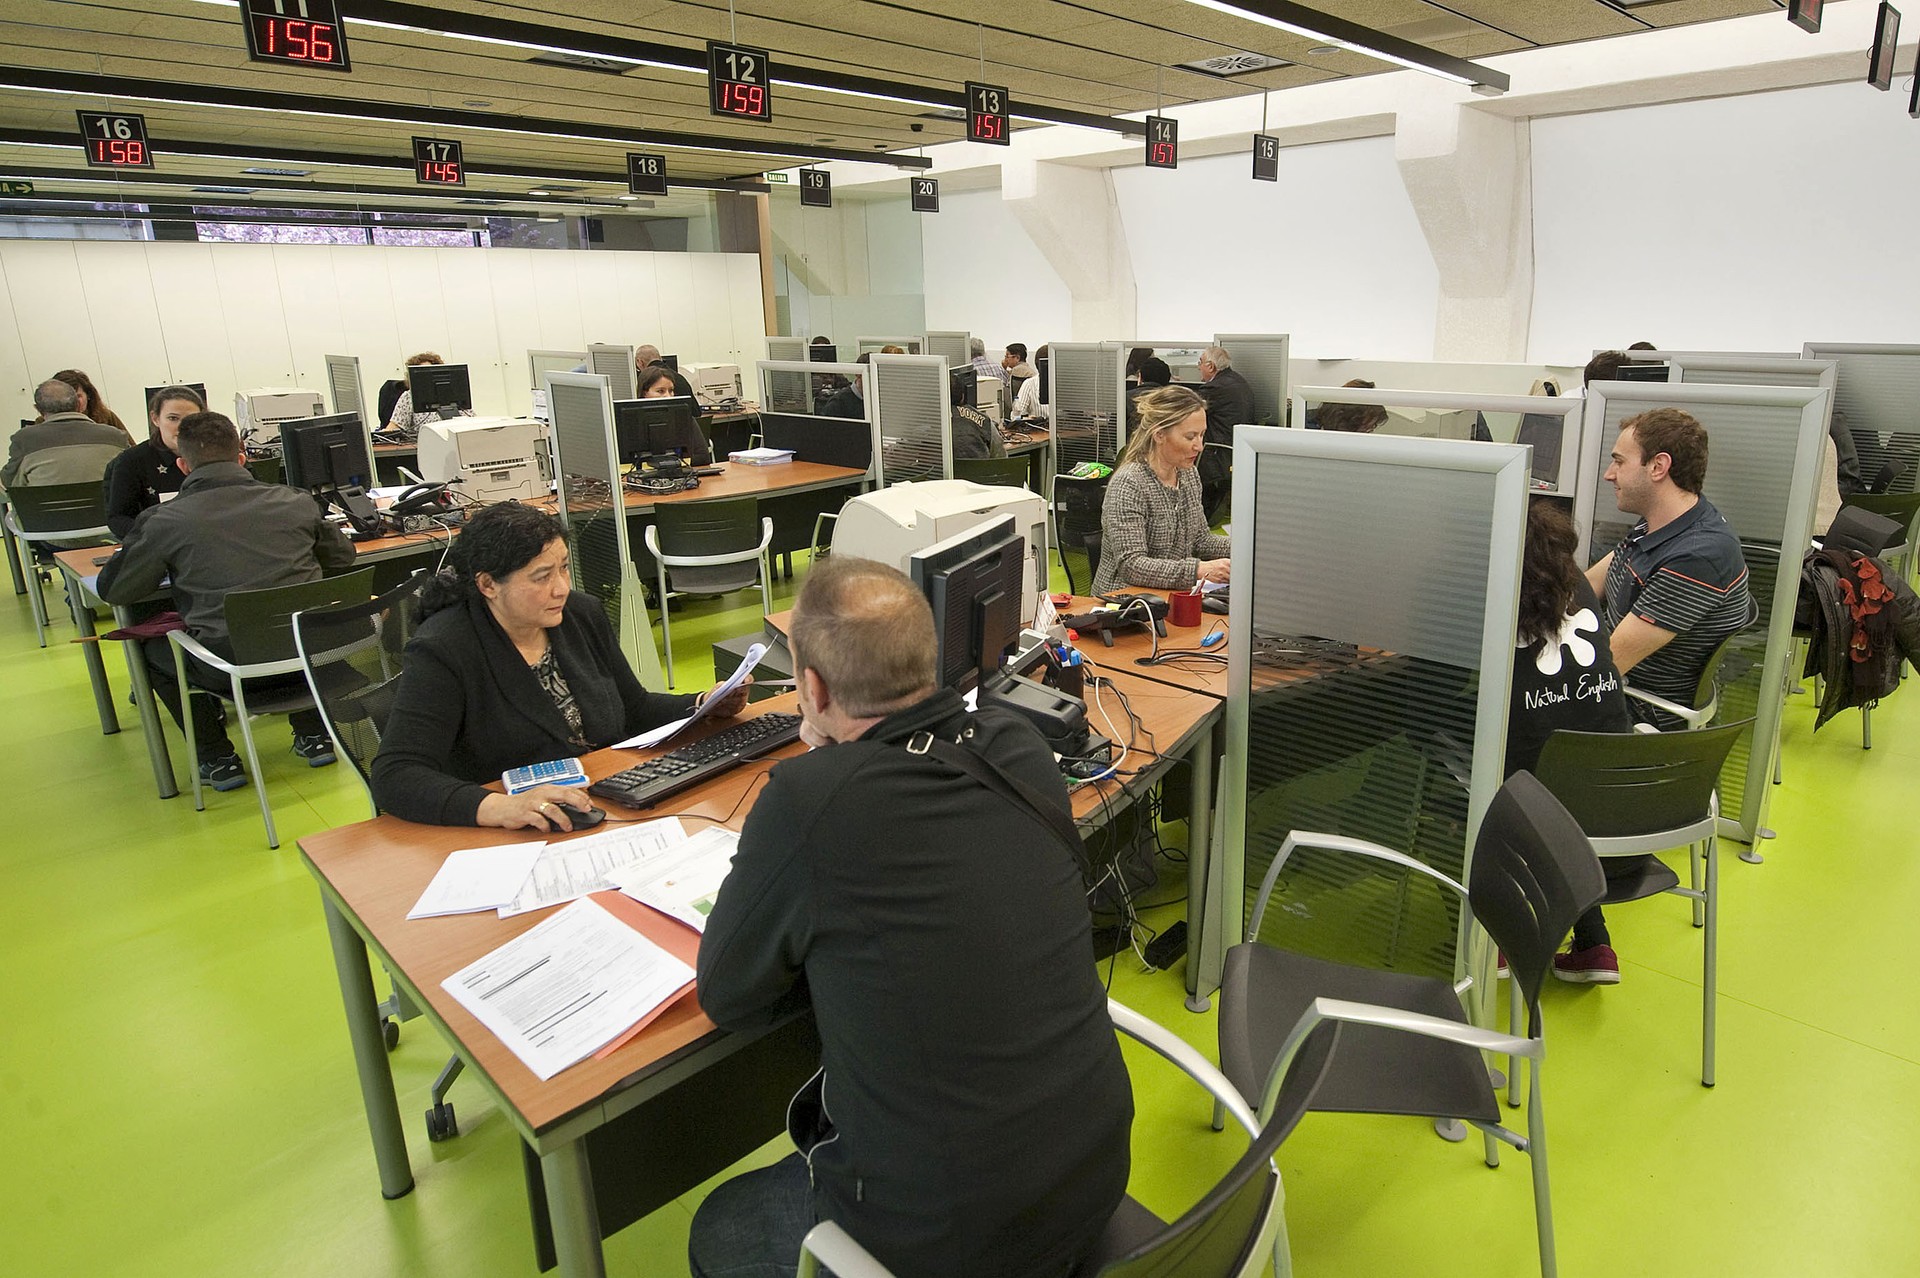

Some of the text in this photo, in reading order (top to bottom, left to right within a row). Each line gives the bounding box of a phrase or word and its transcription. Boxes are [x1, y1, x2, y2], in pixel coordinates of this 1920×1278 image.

[269, 20, 332, 61] 156
[725, 53, 756, 83] 12
[723, 83, 763, 115] 159
[979, 90, 1000, 114] 13
[96, 117, 132, 140] 16
[976, 114, 1002, 138] 151
[1155, 122, 1171, 142] 14
[98, 140, 142, 164] 158
[426, 143, 450, 161] 17
[1152, 143, 1174, 163] 157
[1261, 140, 1274, 158] 15
[425, 162, 458, 182] 145
[638, 158, 658, 174] 18
[808, 173, 824, 187] 19
[919, 182, 933, 195] 20
[956, 405, 986, 428] YORK
[1525, 672, 1617, 709] Natural English
